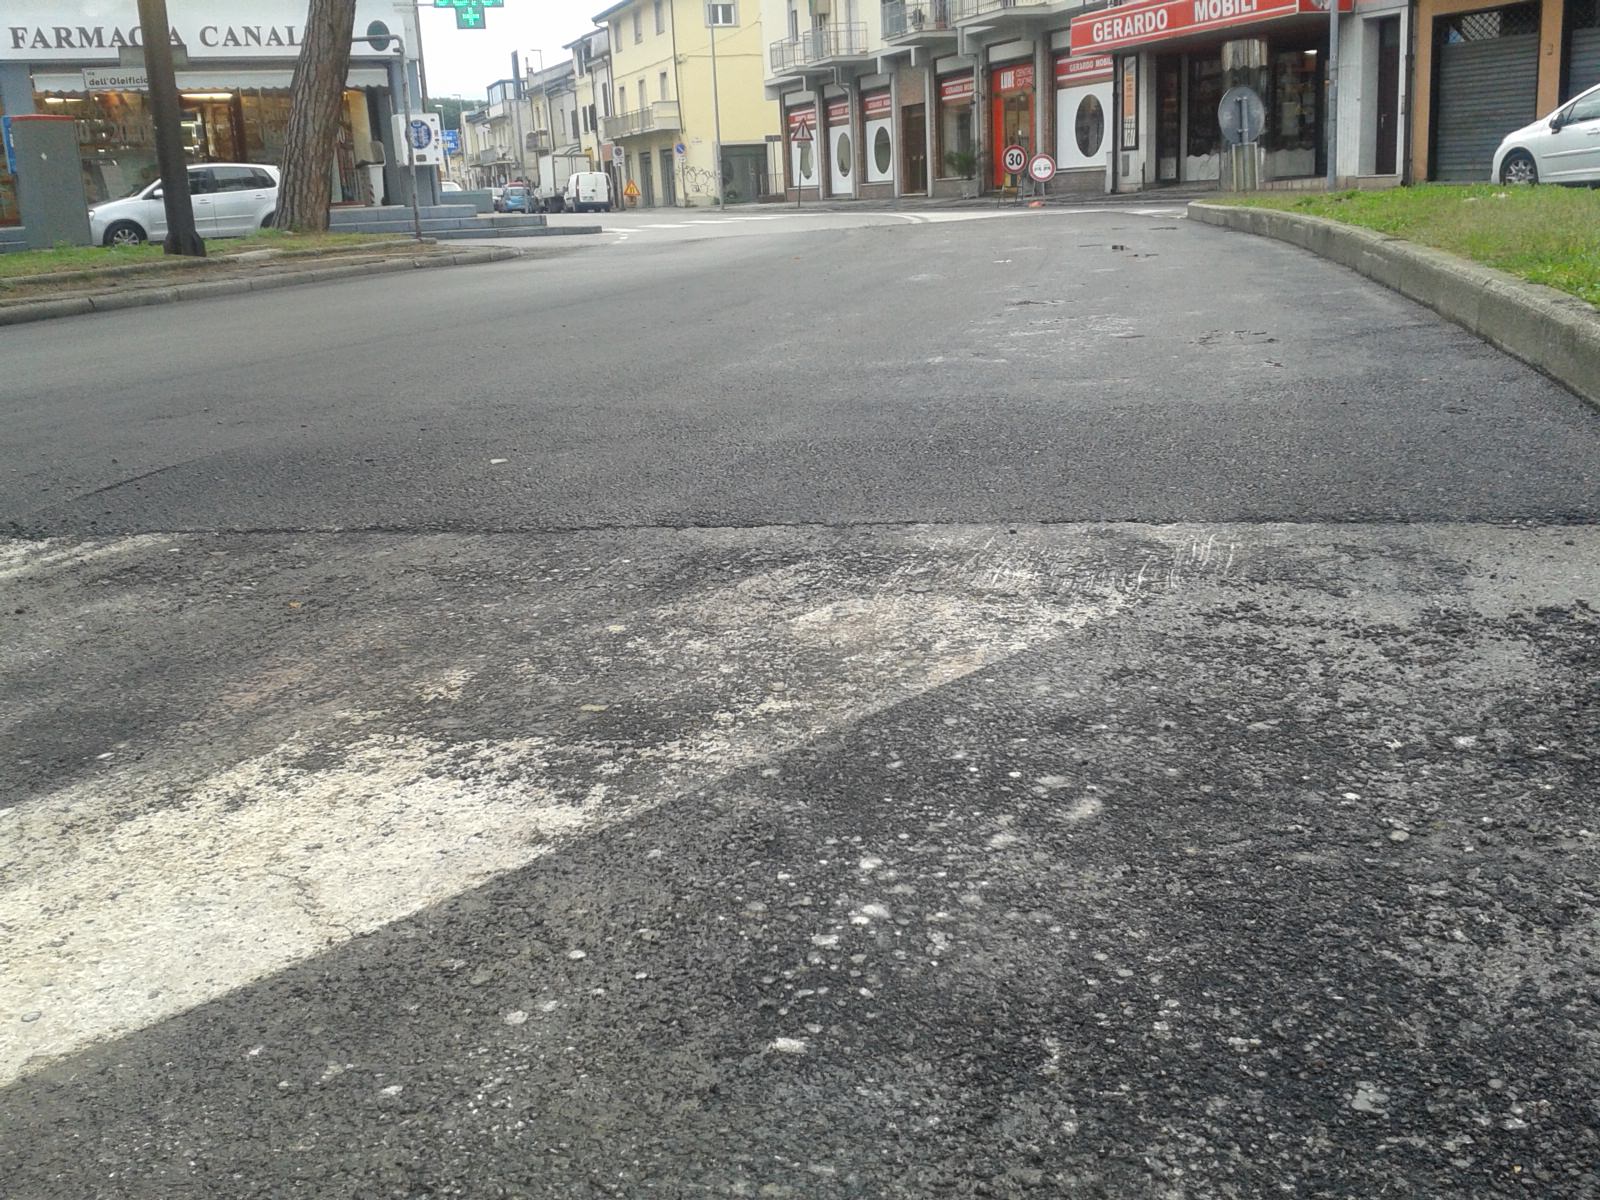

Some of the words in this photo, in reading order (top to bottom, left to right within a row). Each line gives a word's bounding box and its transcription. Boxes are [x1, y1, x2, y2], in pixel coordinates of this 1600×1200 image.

[8, 25, 187, 49] FARMACA
[1092, 9, 1168, 42] GERARDO
[1008, 153, 1022, 166] 30
